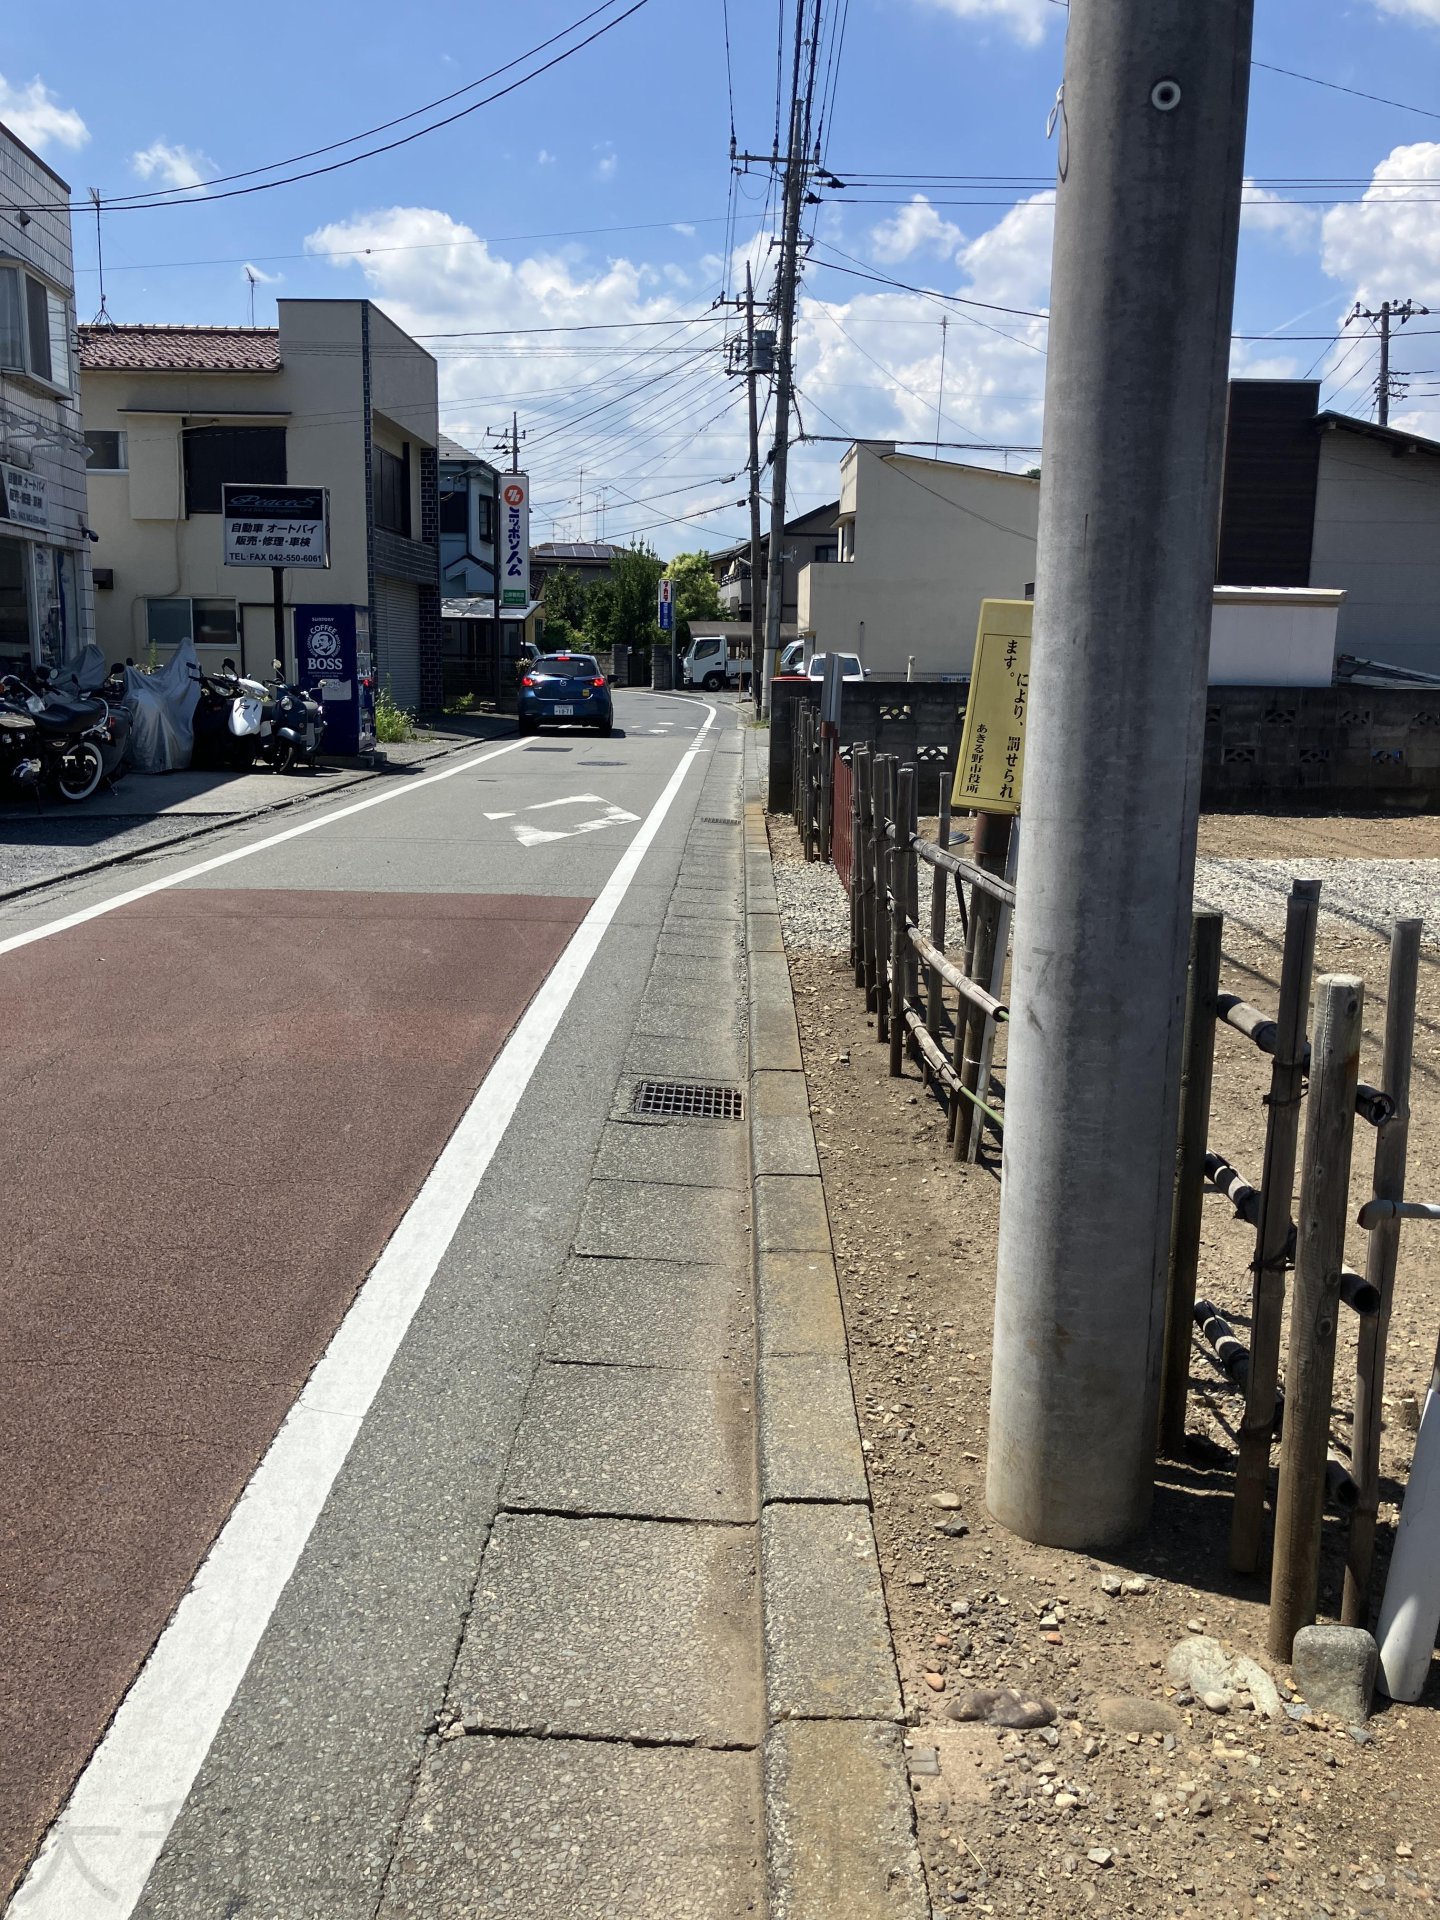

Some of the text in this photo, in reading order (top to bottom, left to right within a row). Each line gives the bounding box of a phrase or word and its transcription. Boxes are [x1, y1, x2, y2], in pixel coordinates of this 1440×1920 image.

[231, 523, 318, 534] 自動車 オートバイ
[506, 506, 523, 576] ニッポンハム
[268, 554, 322, 562] 042-550-6061
[310, 624, 337, 635] COFFEE
[307, 657, 343, 670] BOSS
[966, 723, 988, 794] あきる野市役所
